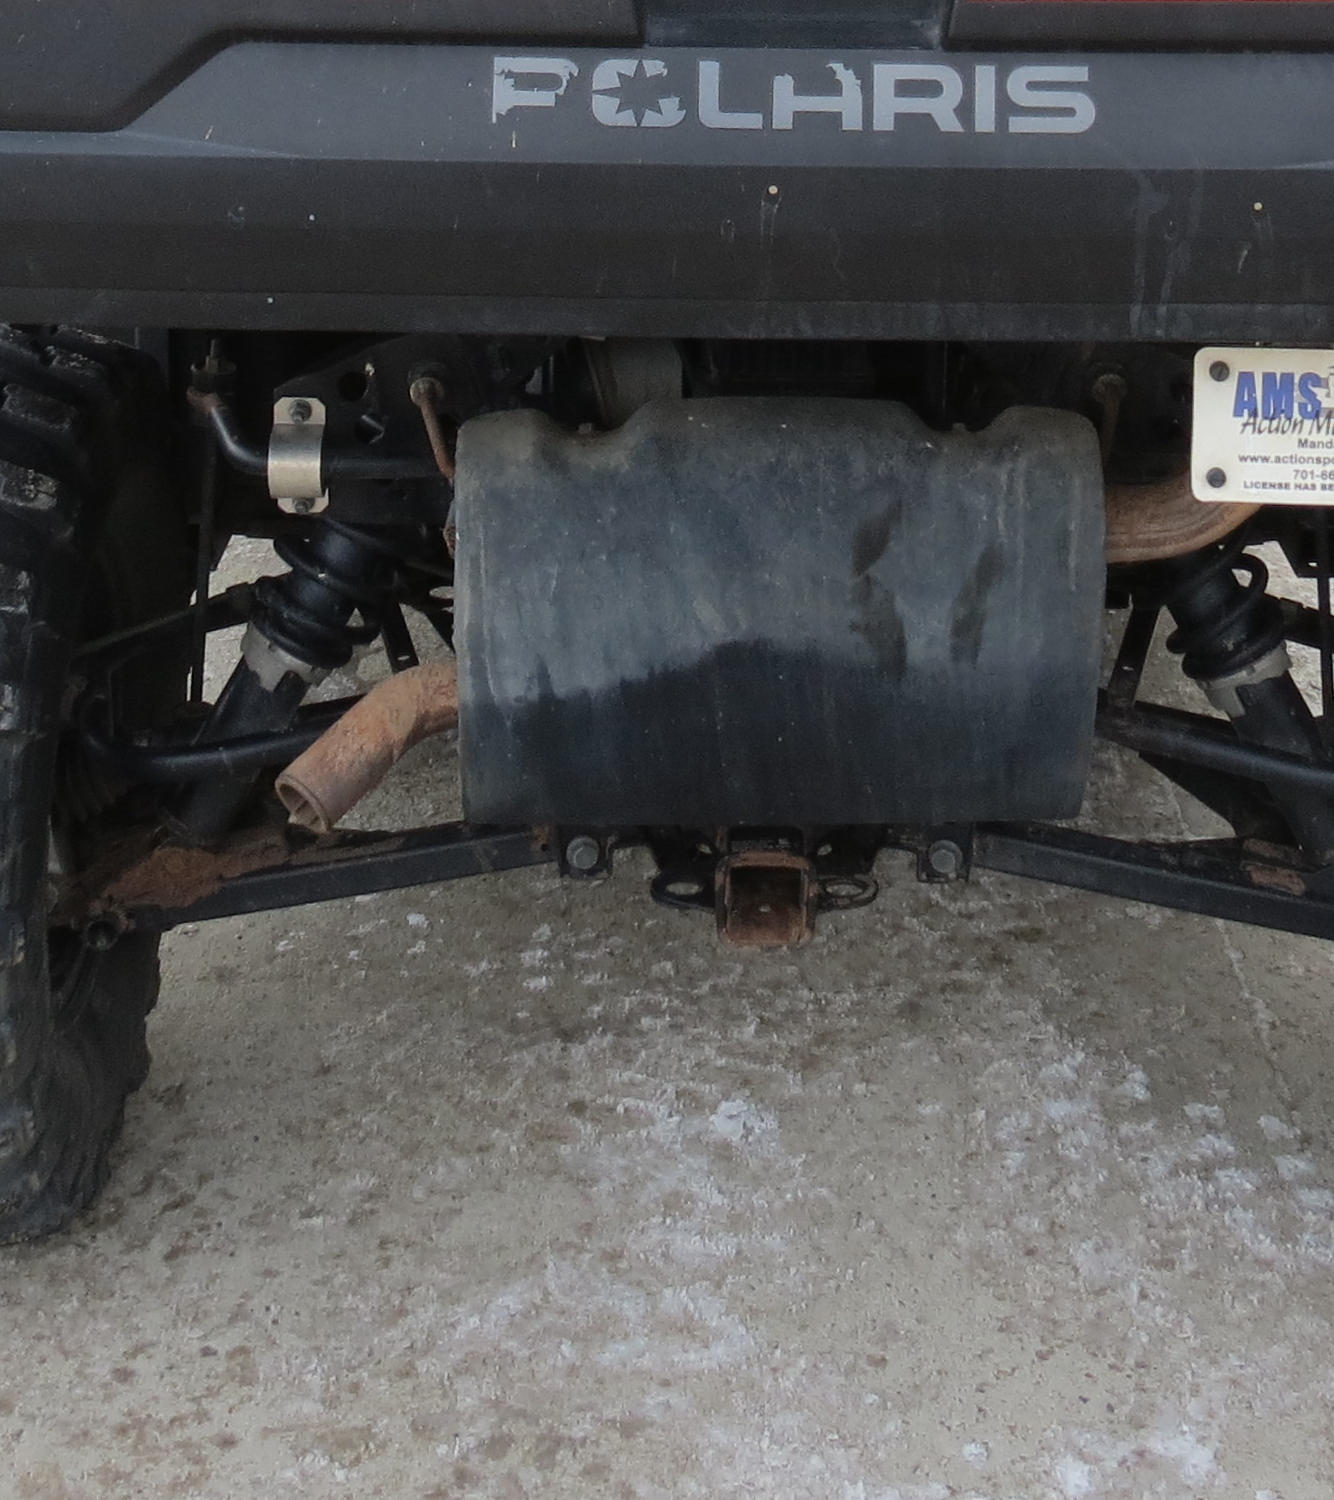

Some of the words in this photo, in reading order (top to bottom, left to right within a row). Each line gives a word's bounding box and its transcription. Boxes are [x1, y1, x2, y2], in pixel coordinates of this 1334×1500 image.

[492, 56, 1097, 134] POLARIS
[1233, 371, 1323, 420] AMS
[1240, 407, 1304, 437] Action
[1243, 481, 1291, 491] LICENSE
[1294, 482, 1317, 492] HAS
